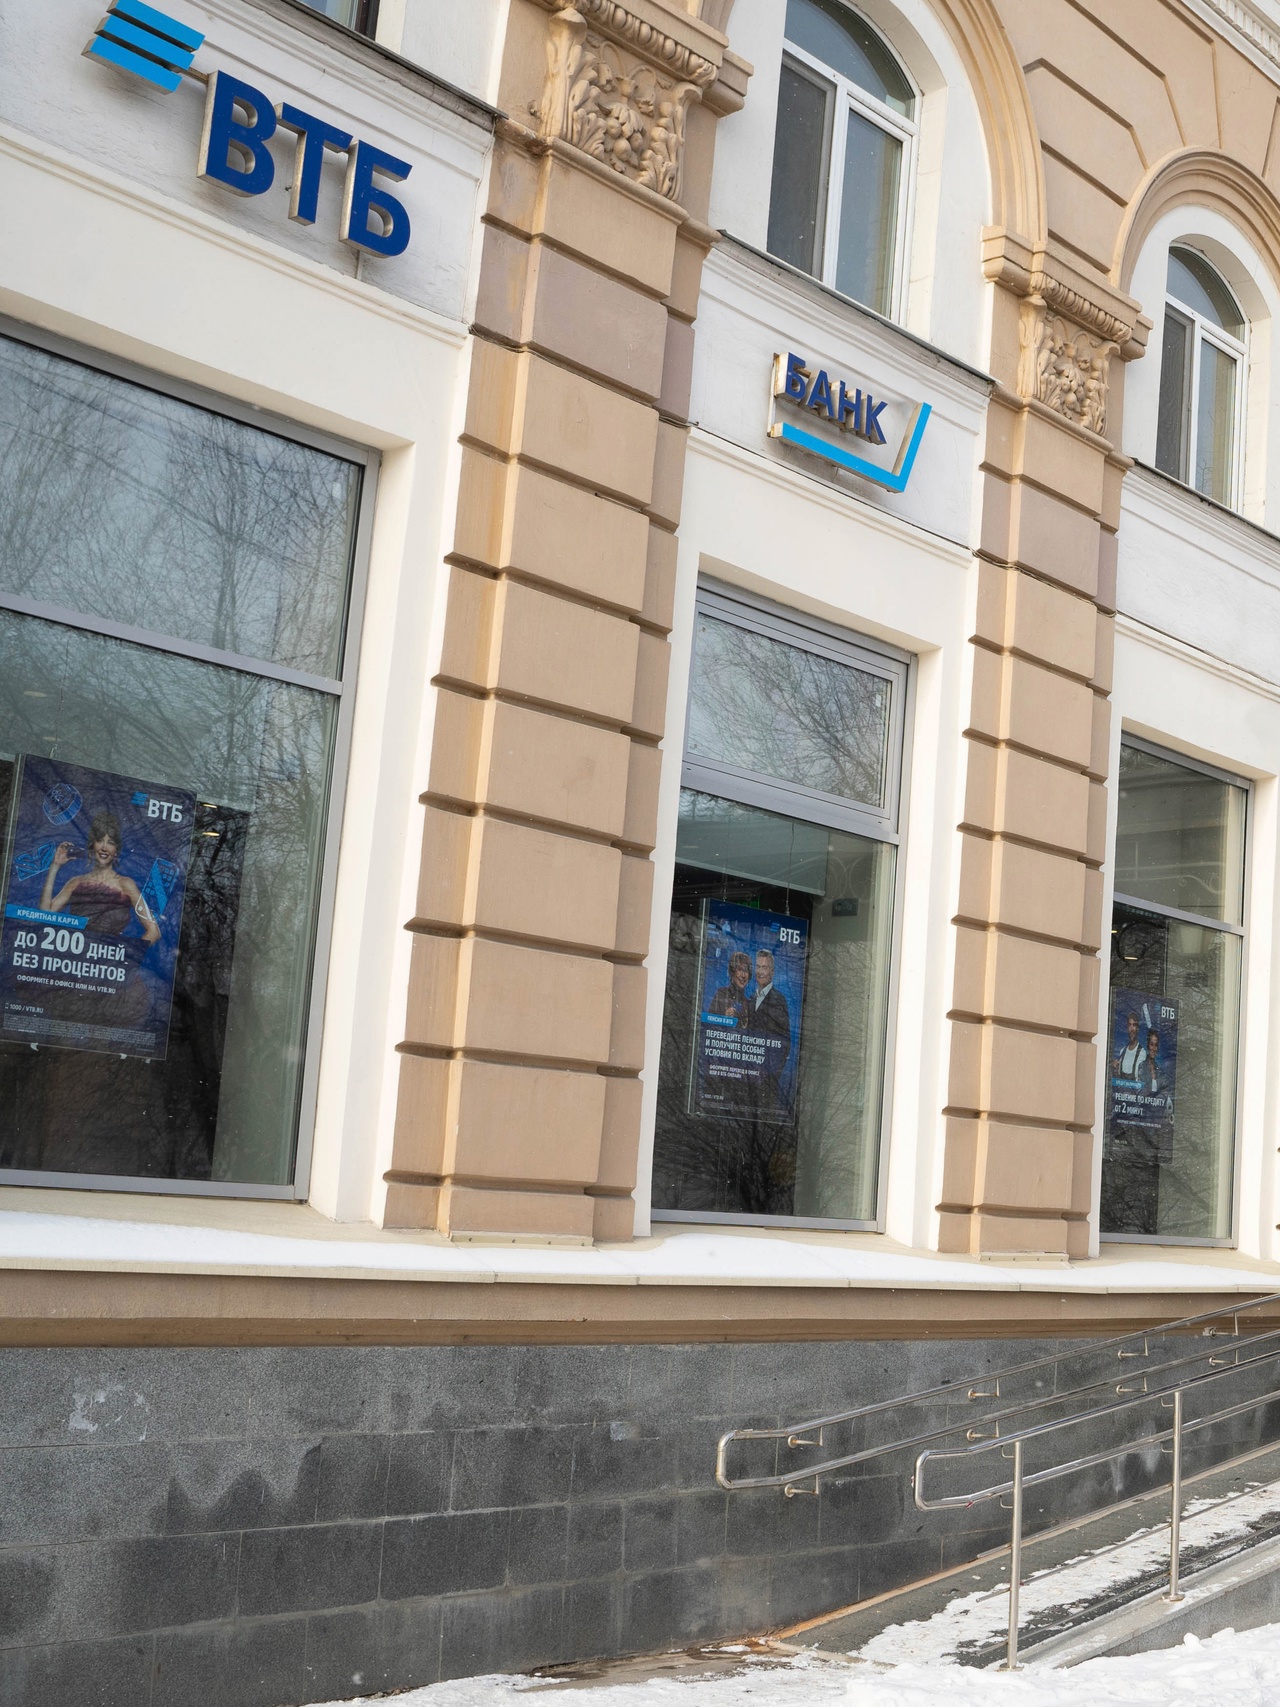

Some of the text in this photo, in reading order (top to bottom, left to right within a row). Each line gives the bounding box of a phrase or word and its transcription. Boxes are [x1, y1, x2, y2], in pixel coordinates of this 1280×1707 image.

[198, 70, 413, 258] ВТБ
[777, 352, 888, 445] БАНК
[147, 799, 183, 823] ВТБ
[17, 909, 79, 926] КРЕДИТНАЯ КАРТА
[14, 927, 125, 961] ДО 200 ДНЕЙ
[780, 927, 800, 944] ВТБ
[13, 952, 126, 982] БЕЗ ПРОЦЕНТОВ
[17, 974, 49, 985] ОФОРМИТЕ
[54, 980, 75, 989] ОФИСЕ
[75, 982, 88, 990] ИЛИ
[88, 984, 97, 992] НА
[1161, 1006, 1175, 1020] ВТБ
[706, 1030, 741, 1042] ПЕРЕВЕДИТЕ
[742, 1035, 765, 1045] ПЕНСИЮ
[771, 1040, 782, 1048] ВТБ
[711, 1040, 741, 1051] ПОЛУЧИТЕ
[742, 1045, 765, 1055] ОСОБЫЕ
[705, 1048, 765, 1065] УСЛОВИЯ ПО ВКЛАДУ
[1115, 1092, 1137, 1103] РЕШЕНИЕ
[1145, 1096, 1165, 1107] КРЕДИТУ
[1122, 1102, 1127, 1114] 2
